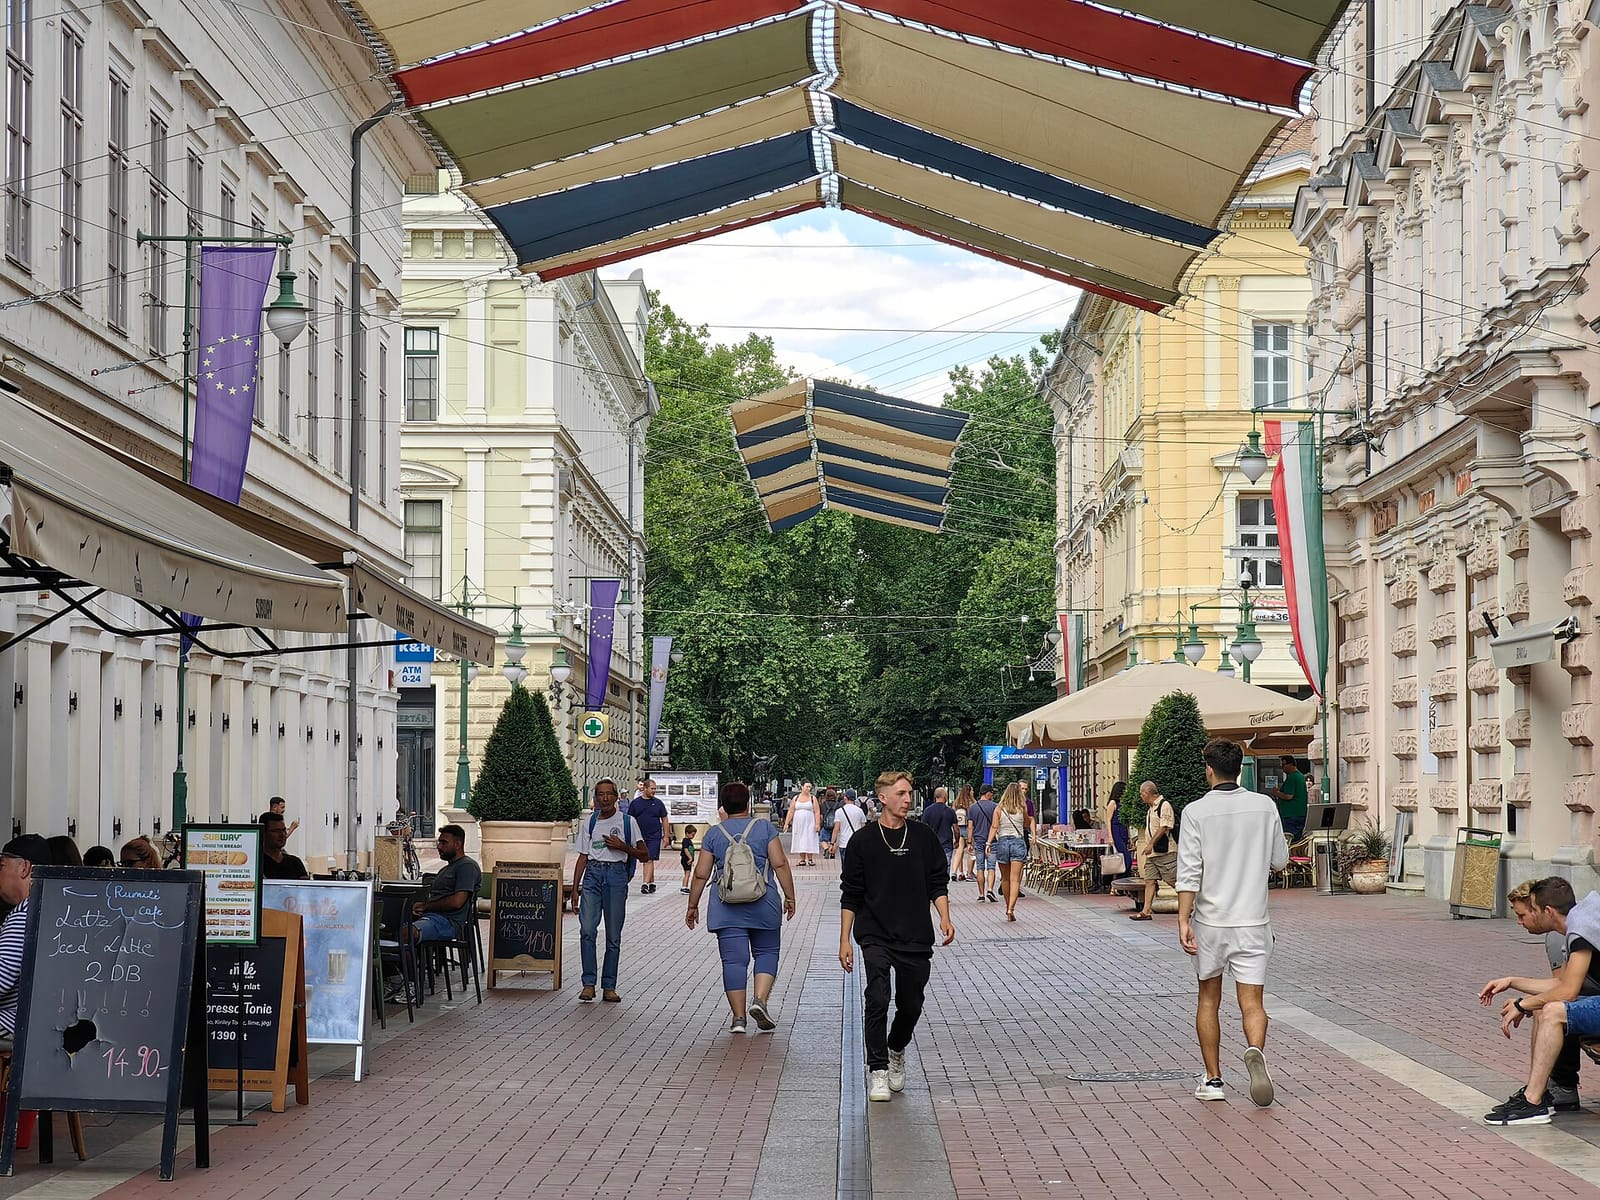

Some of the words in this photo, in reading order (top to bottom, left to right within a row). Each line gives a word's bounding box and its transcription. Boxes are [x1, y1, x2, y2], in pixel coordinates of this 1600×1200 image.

[402, 666, 422, 674] ATM
[402, 675, 421, 683] 0-24
[1036, 769, 1043, 778] P
[203, 833, 242, 841] SUBWAY
[55, 905, 113, 928] Latte
[103, 936, 155, 957] Latte
[84, 961, 104, 982] 2
[110, 964, 142, 982] DB
[243, 1001, 272, 1015] Tonic
[211, 1031, 236, 1041] 1390
